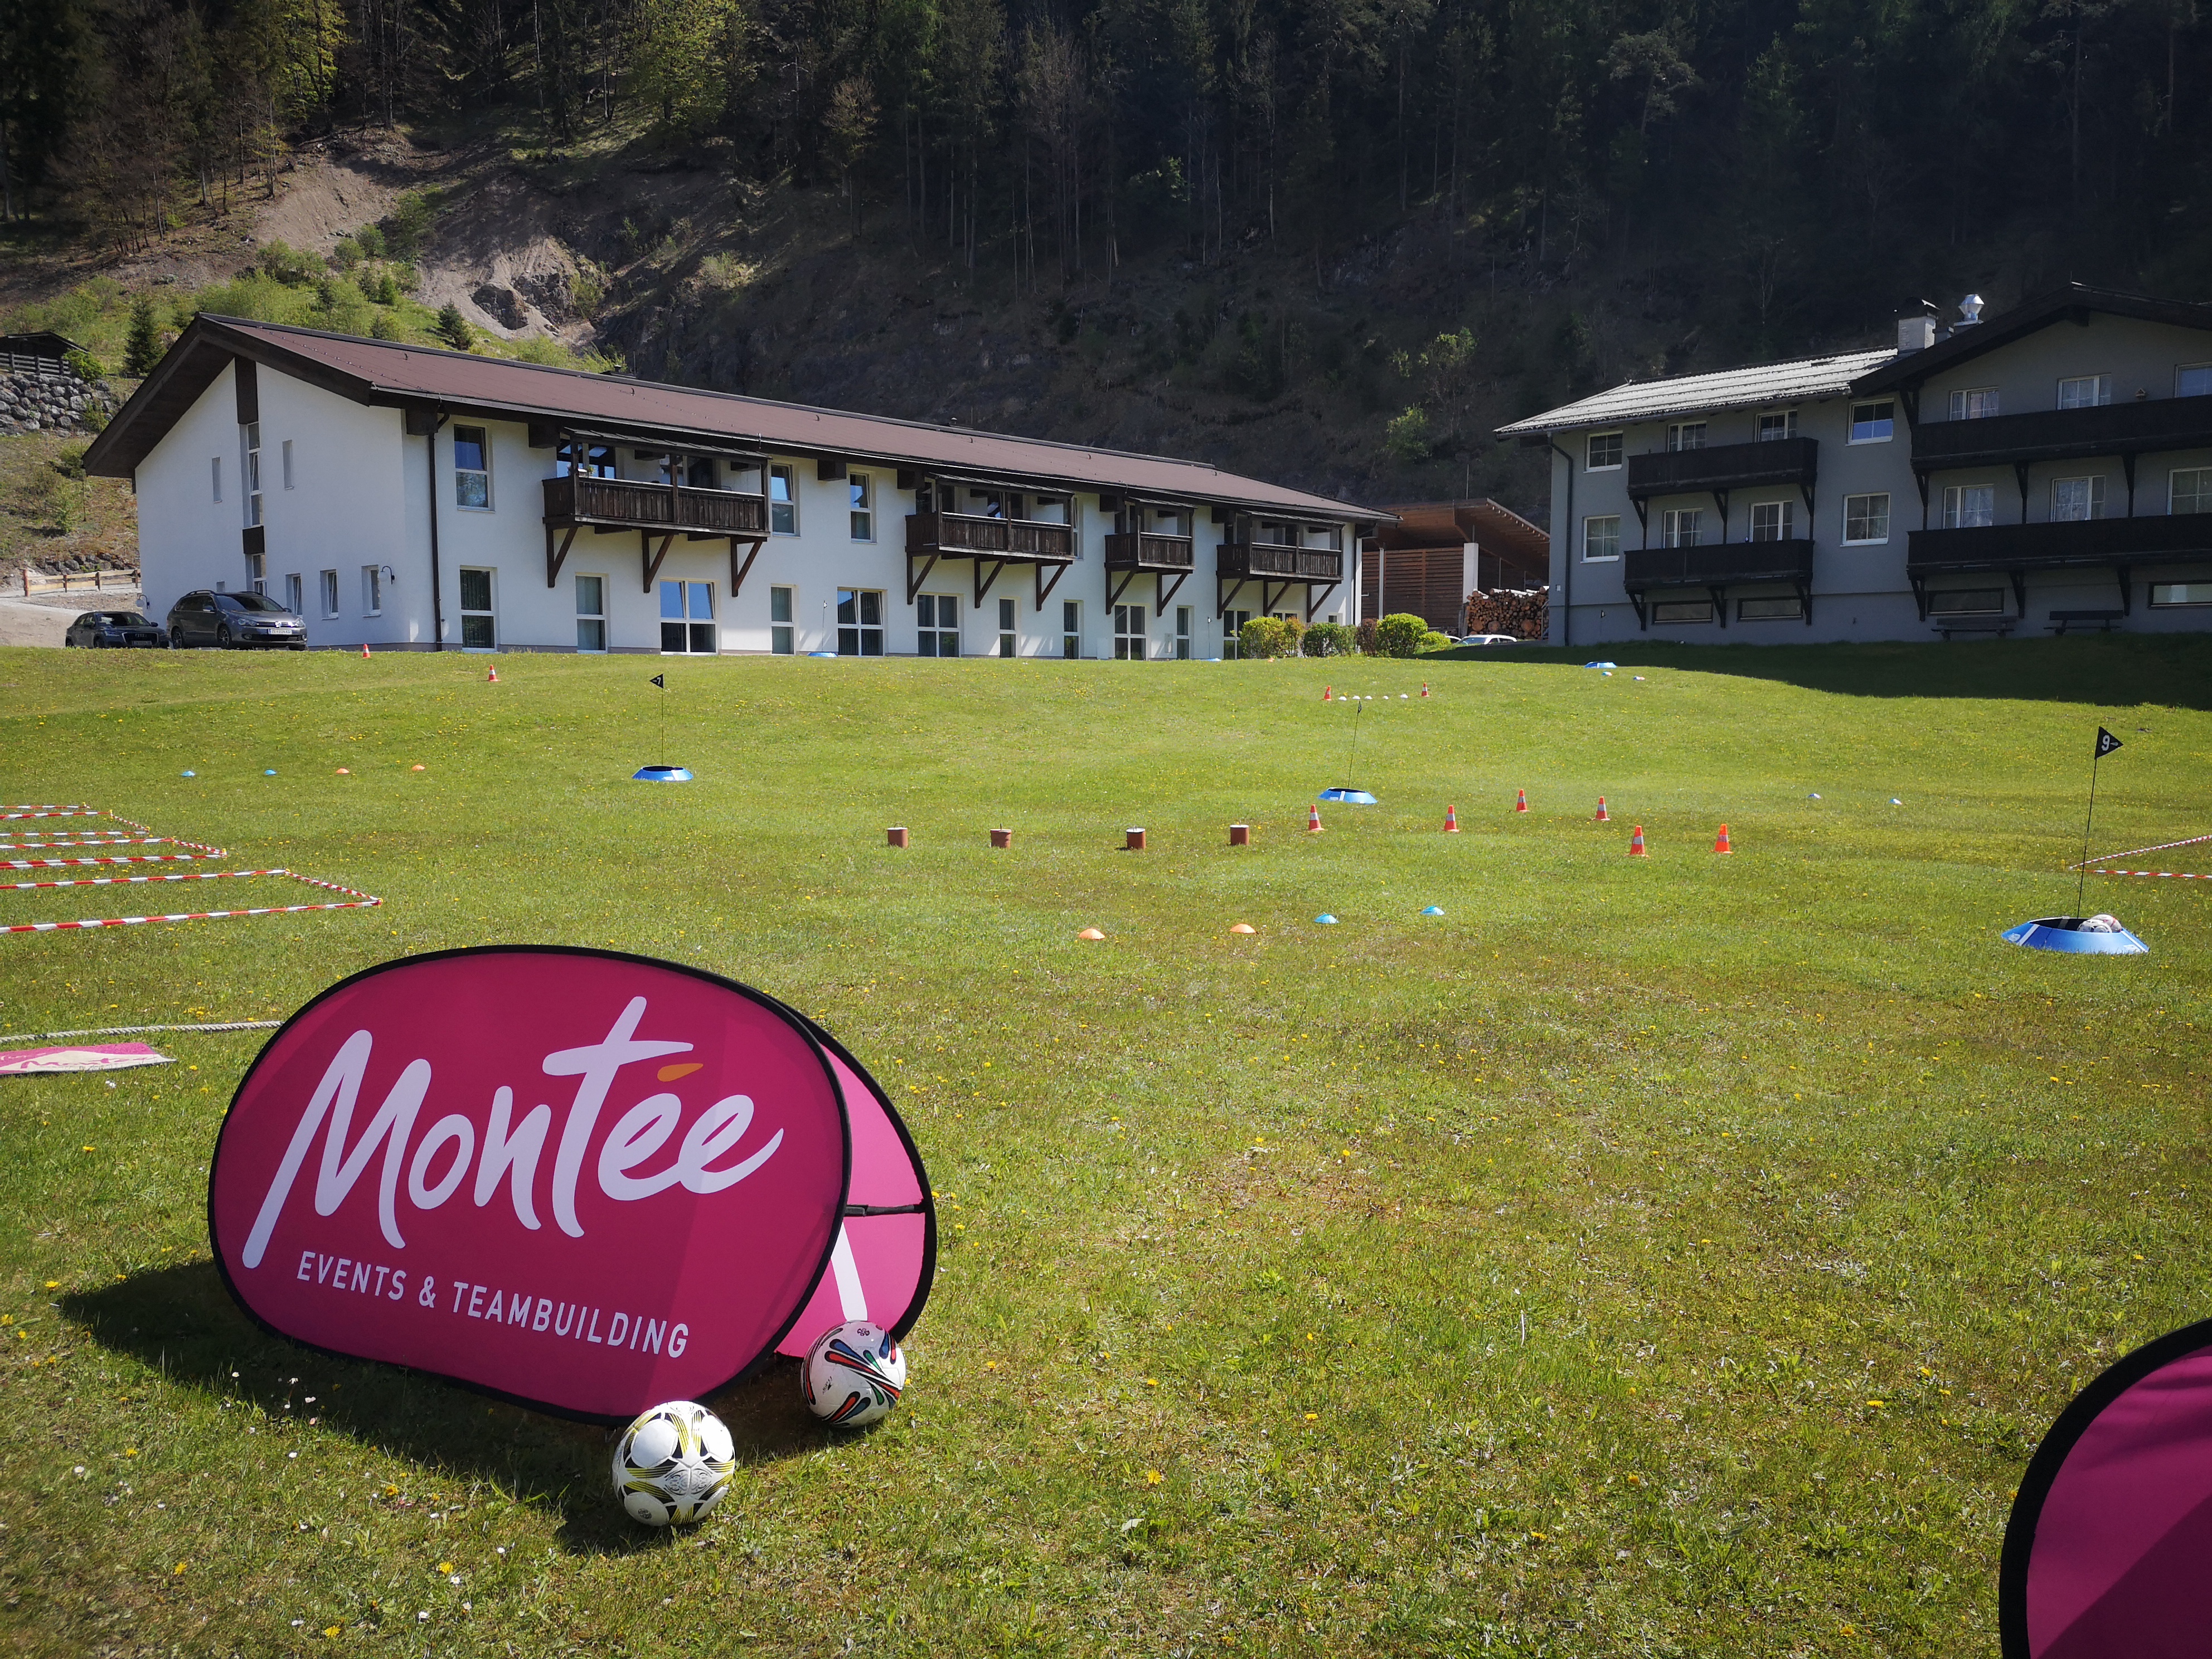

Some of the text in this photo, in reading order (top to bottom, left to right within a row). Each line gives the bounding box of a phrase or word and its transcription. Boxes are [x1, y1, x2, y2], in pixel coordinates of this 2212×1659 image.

[2101, 735, 2111, 751] 9
[241, 996, 784, 1269] Montée
[297, 1250, 689, 1359] EVENTS & TEAMBUILDING
